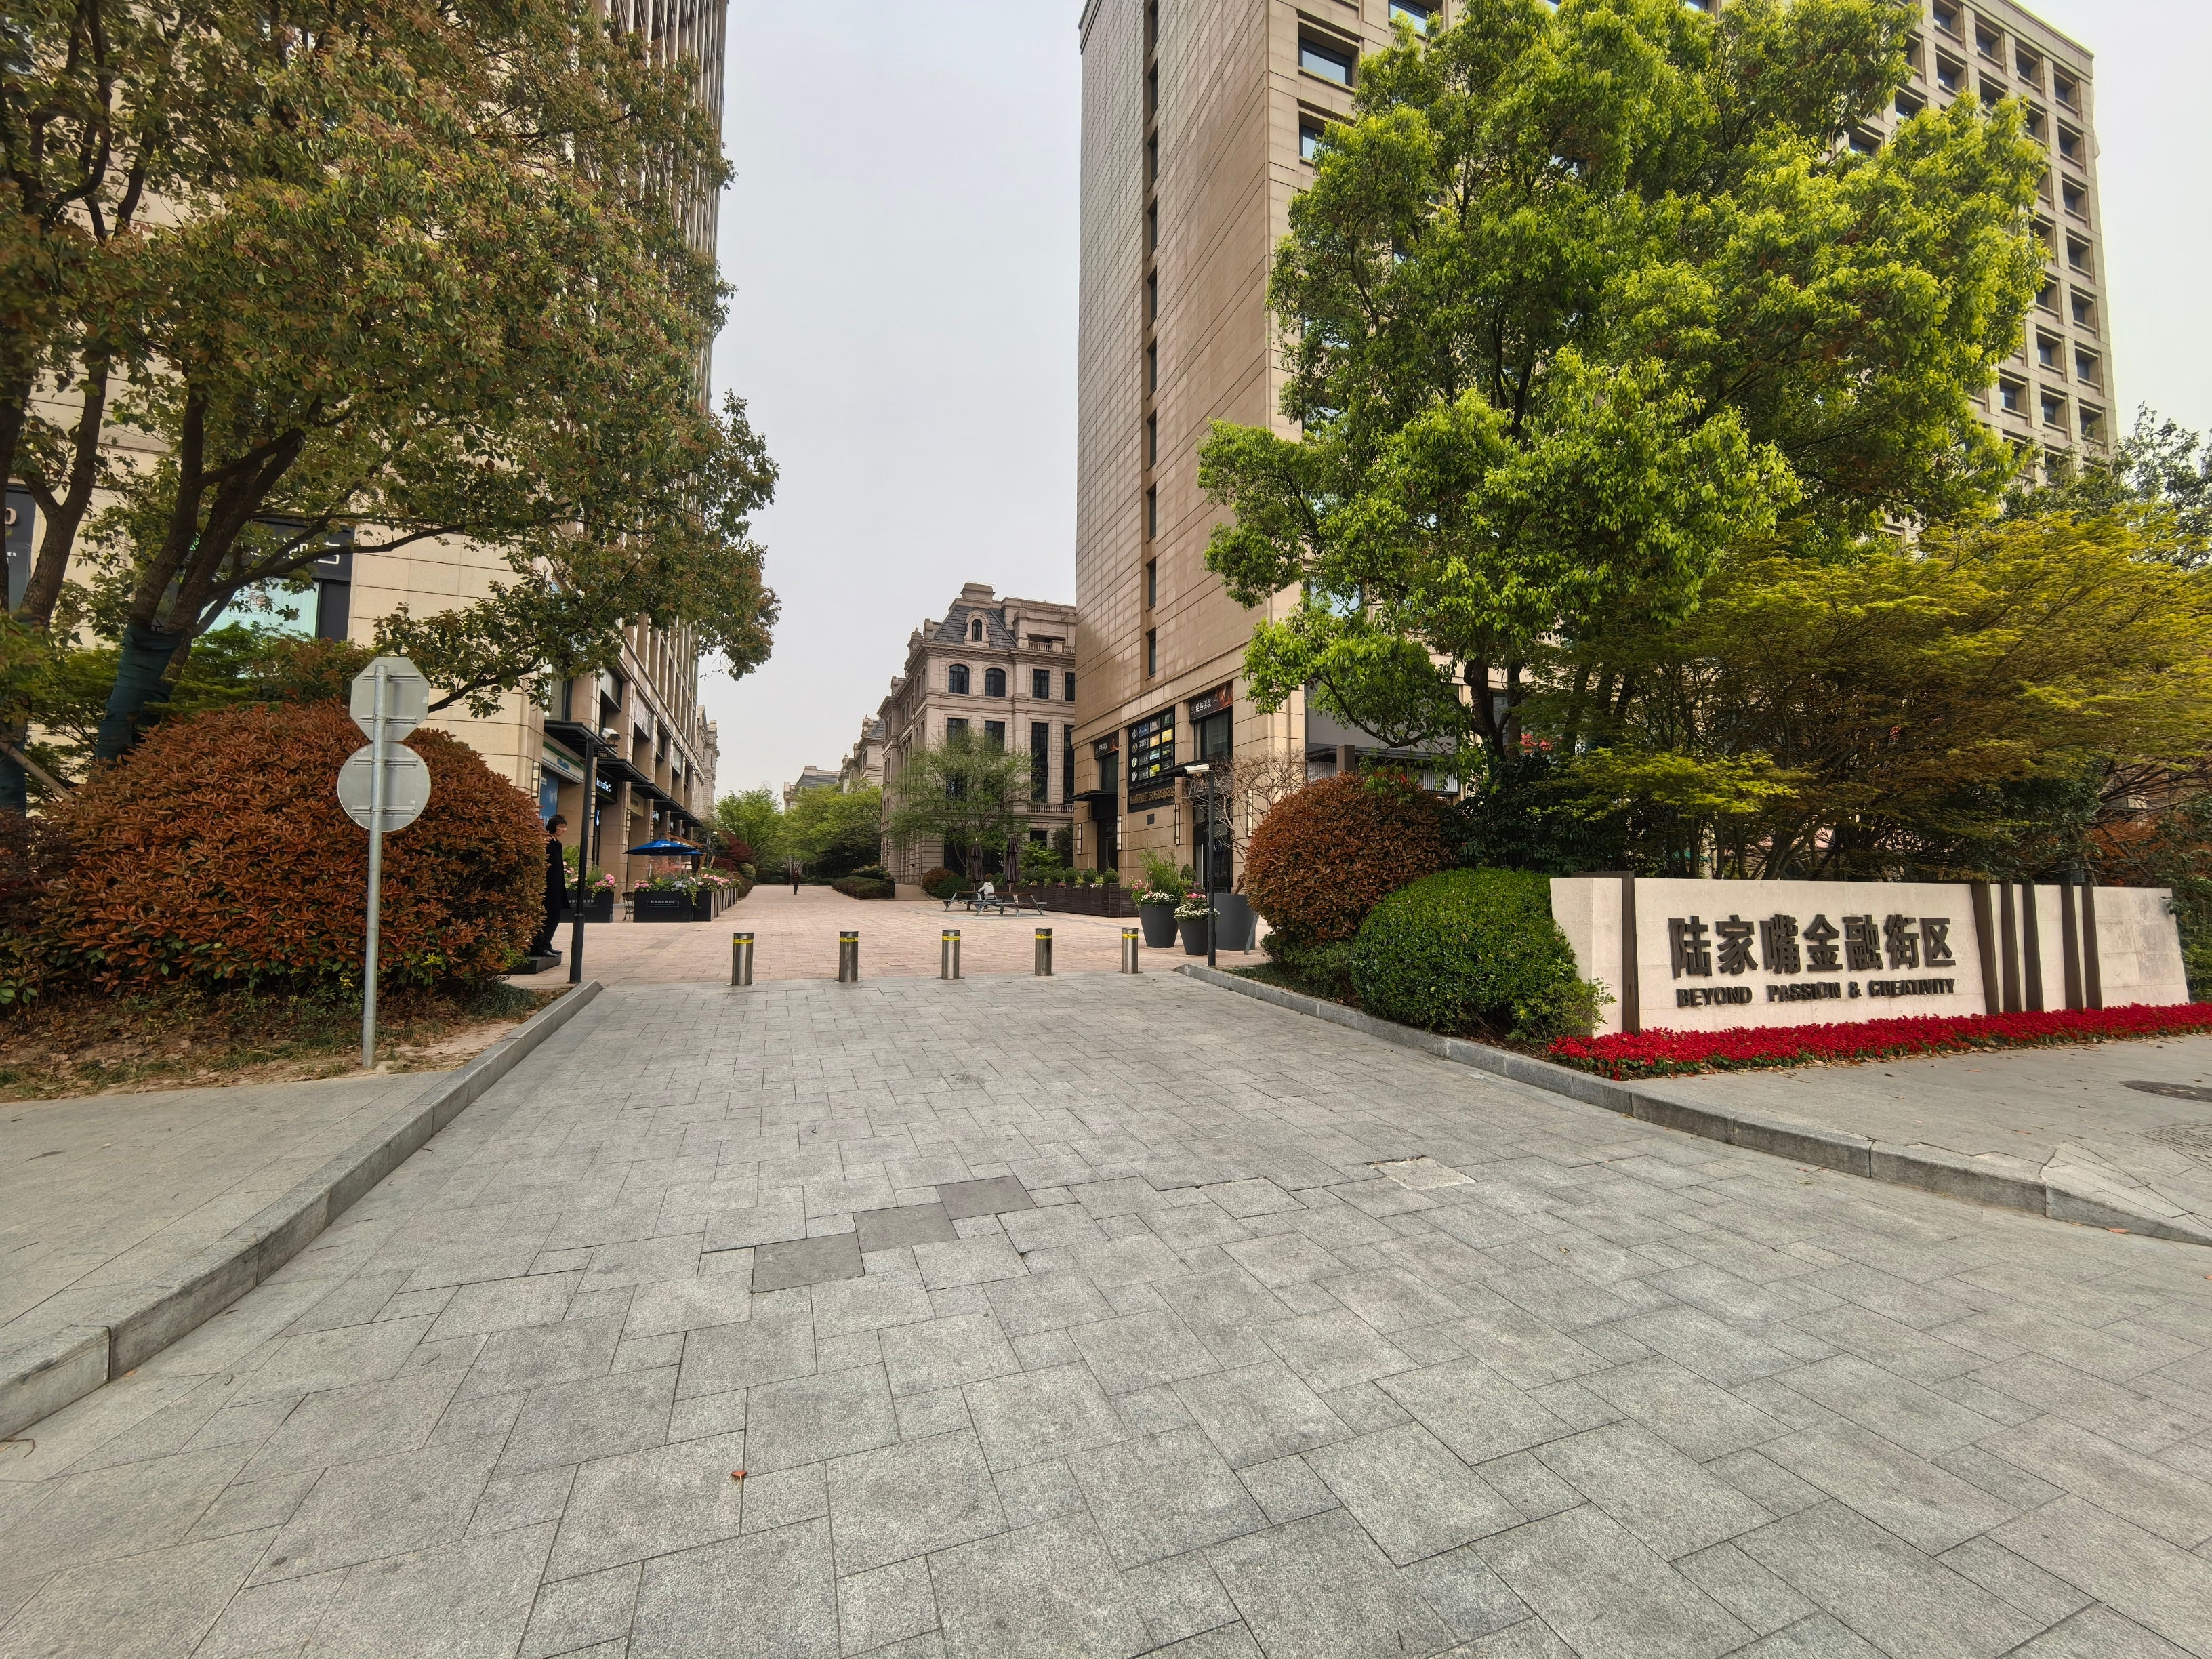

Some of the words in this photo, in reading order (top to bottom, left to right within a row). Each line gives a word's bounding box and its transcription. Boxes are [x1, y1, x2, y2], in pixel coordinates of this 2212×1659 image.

[1668, 914, 1956, 978] 陆家嘴金融街区
[1676, 987, 1753, 1006] BEYOND
[1766, 982, 1841, 1001] PASSION
[1848, 981, 1862, 998] &
[1867, 978, 1955, 996] CREATIVITY
